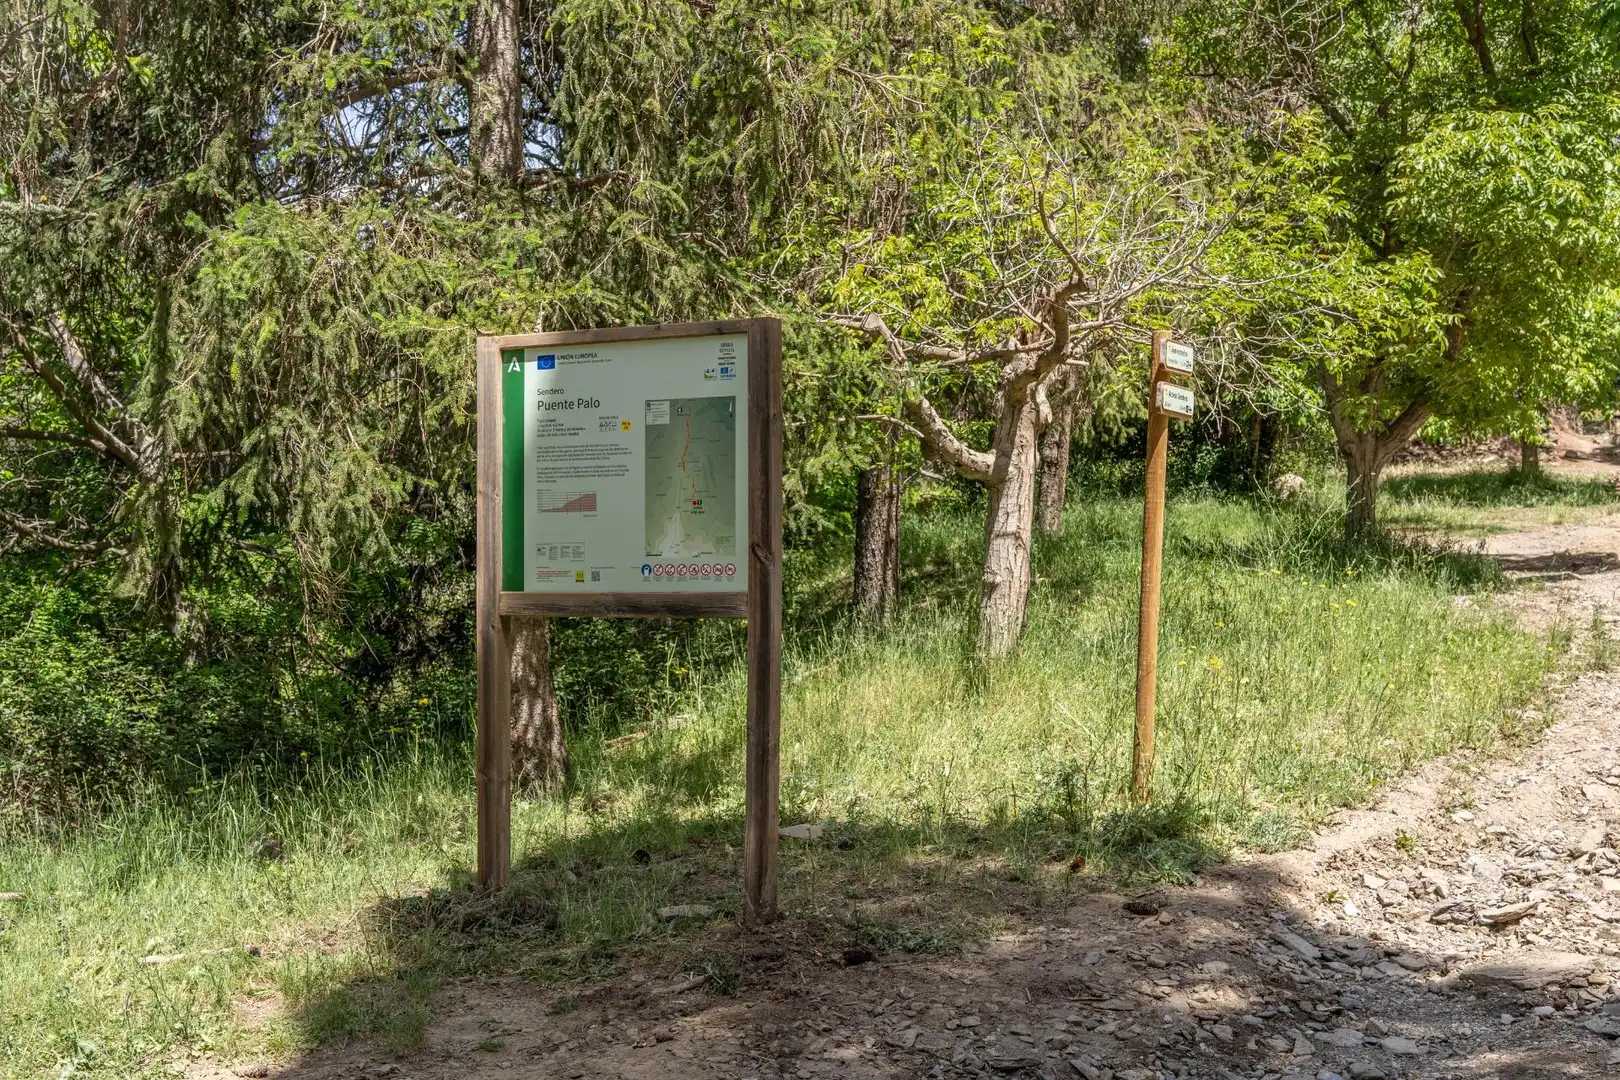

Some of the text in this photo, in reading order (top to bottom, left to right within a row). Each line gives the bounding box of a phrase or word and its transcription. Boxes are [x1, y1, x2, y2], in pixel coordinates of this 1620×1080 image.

[557, 352, 598, 361] UNIÓN EUROPEA
[537, 388, 565, 396] Sendero
[537, 397, 600, 411] Puente Palo
